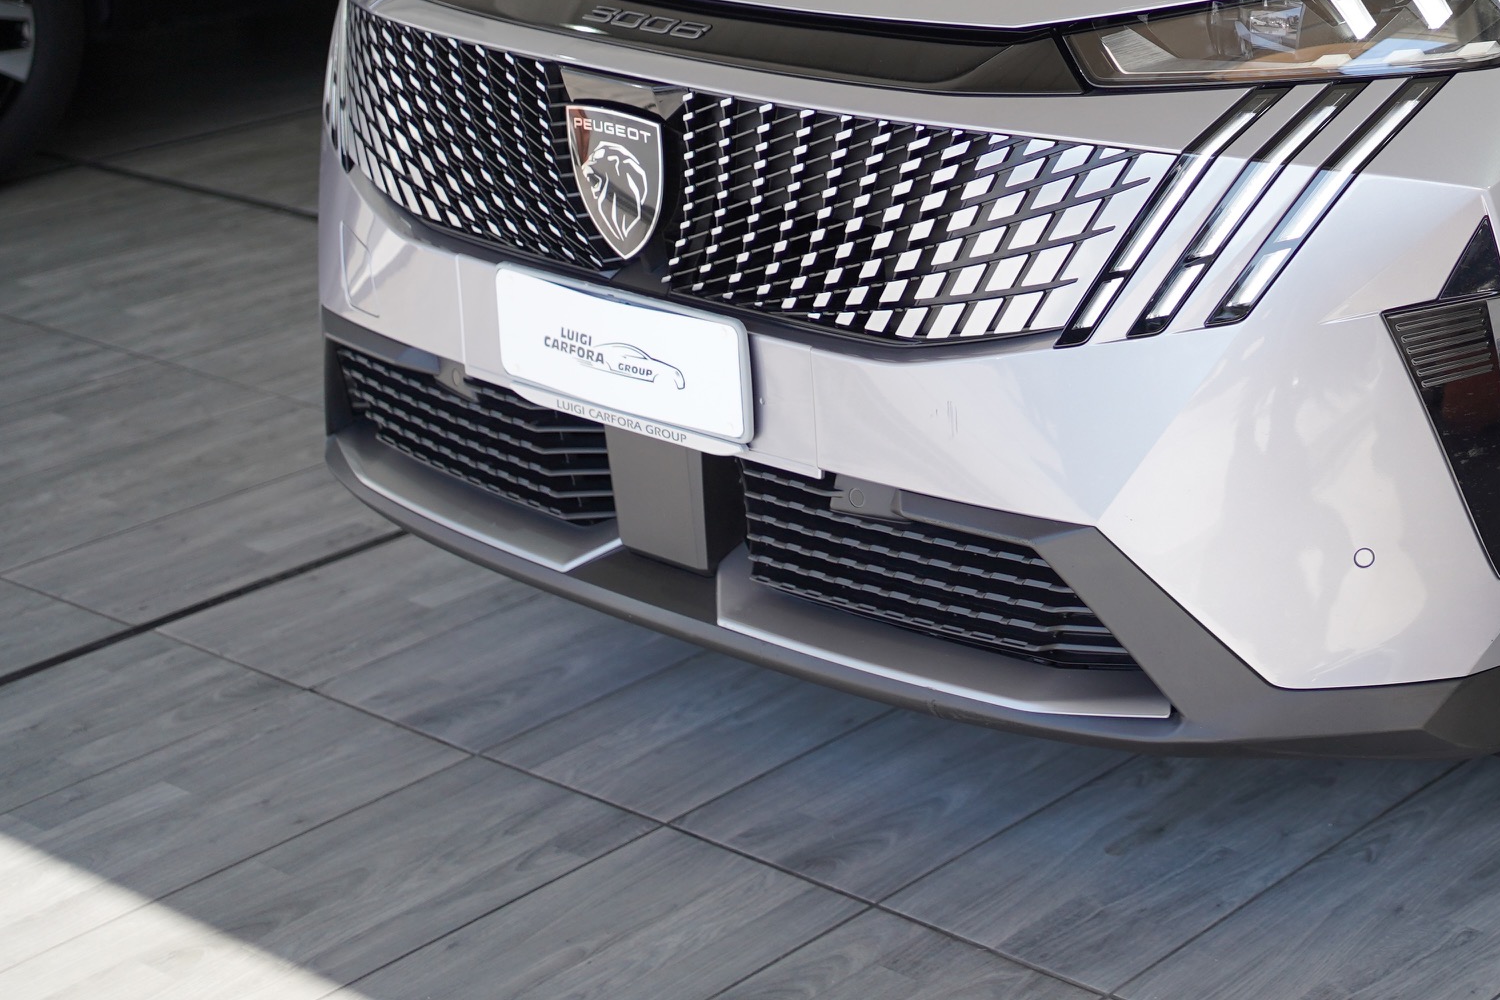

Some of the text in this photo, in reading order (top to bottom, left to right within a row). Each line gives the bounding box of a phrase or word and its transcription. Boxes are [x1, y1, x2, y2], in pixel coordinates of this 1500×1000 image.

[582, 5, 712, 40] 3008
[573, 117, 651, 143] PEUGEOT
[544, 336, 604, 364] CARFORA
[560, 327, 592, 347] LUIGI
[618, 363, 653, 377] GROUP
[557, 399, 687, 443] LUIGI CARFORA GROUP
